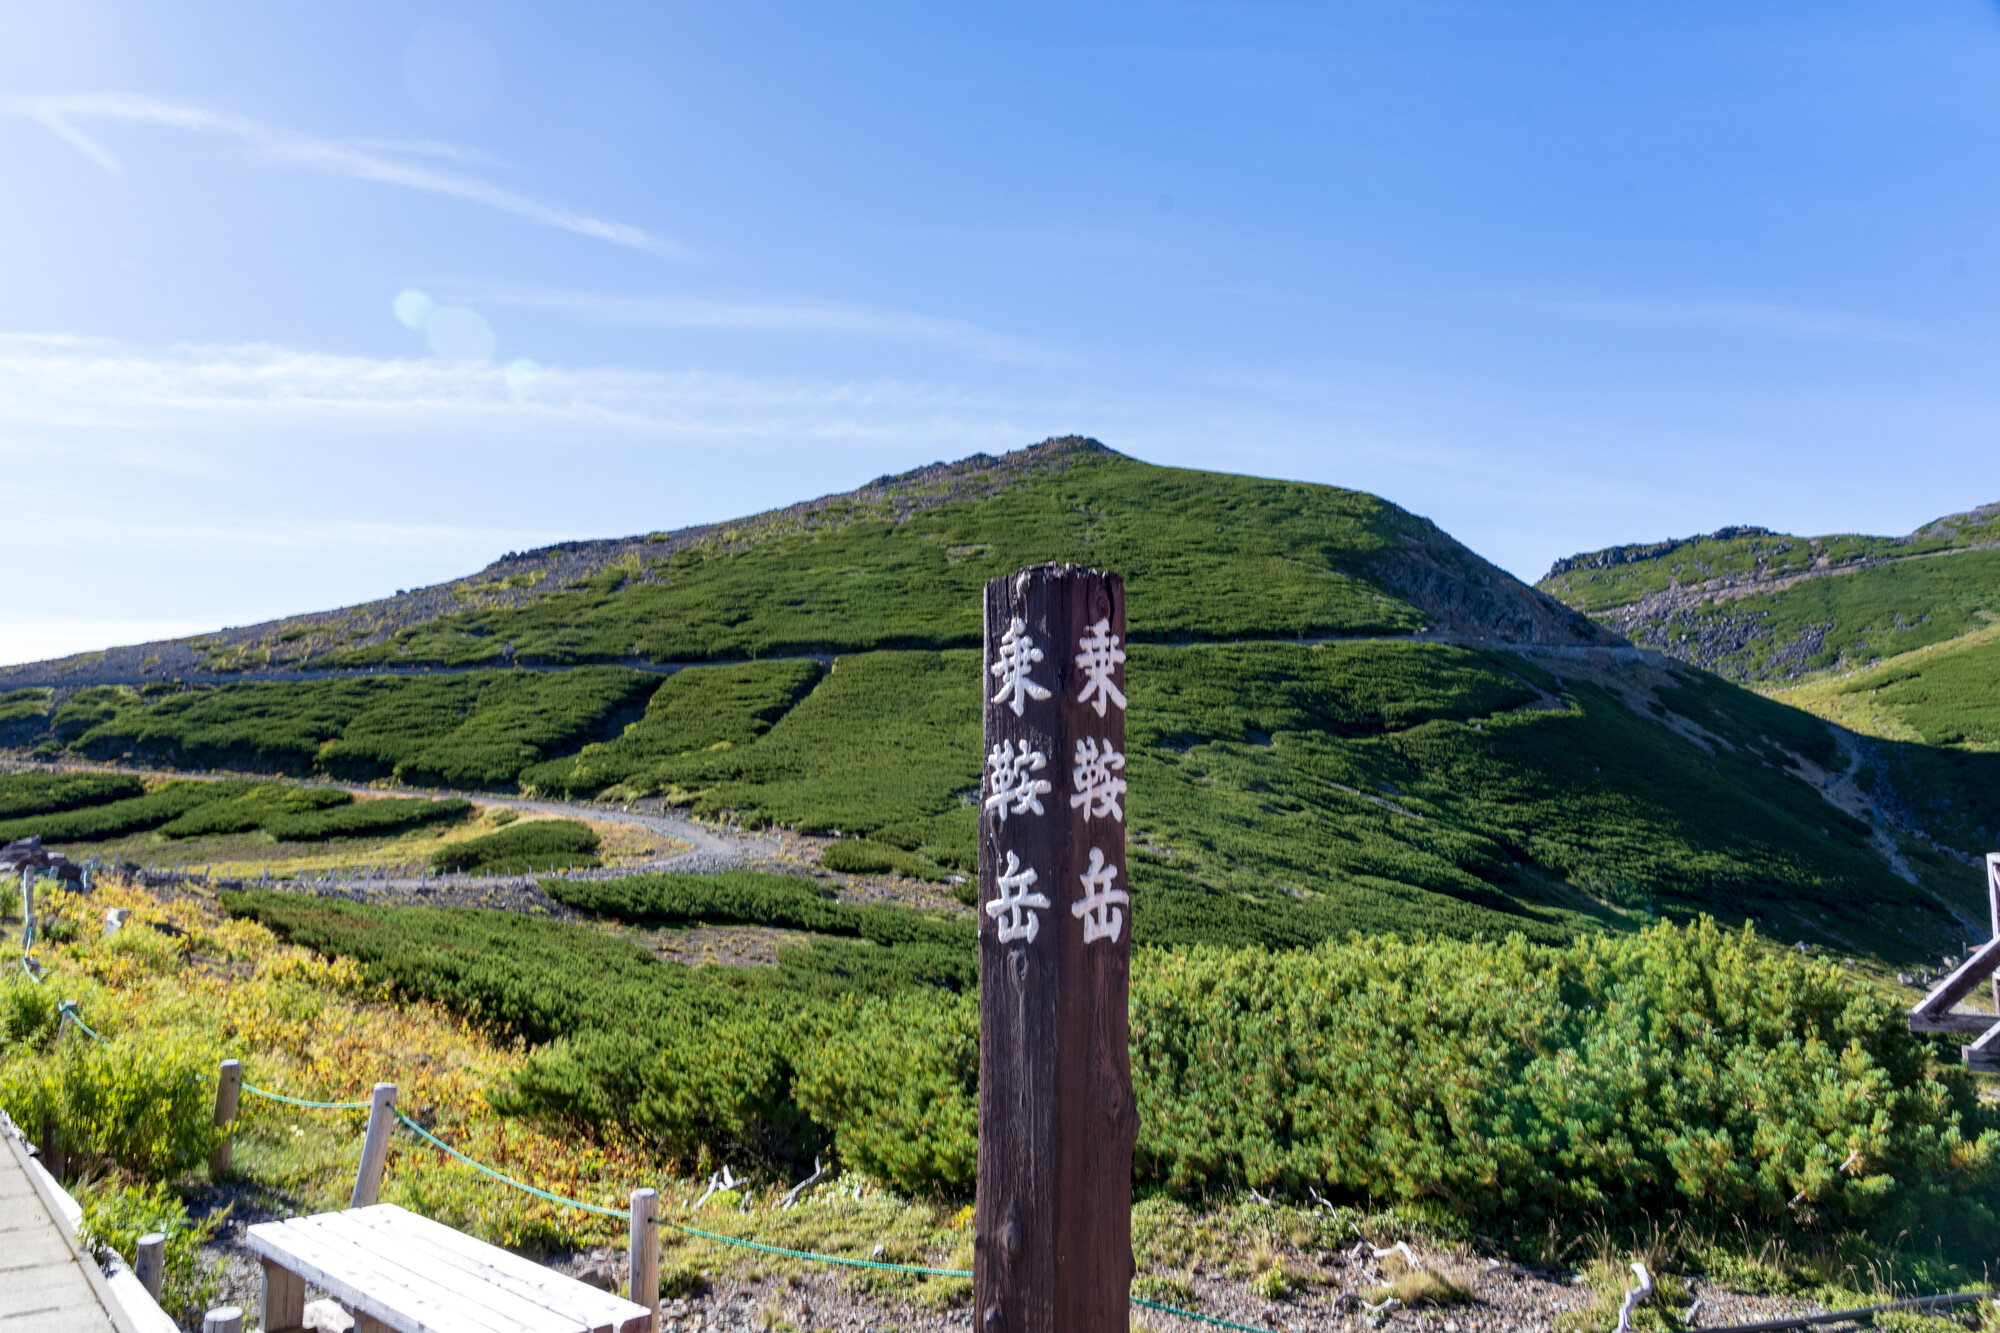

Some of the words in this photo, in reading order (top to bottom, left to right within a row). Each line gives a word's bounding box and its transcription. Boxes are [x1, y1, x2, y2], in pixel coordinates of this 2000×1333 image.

[985, 617, 1052, 944] 乗鞍岳
[1070, 617, 1130, 944] 乗鞍岳
